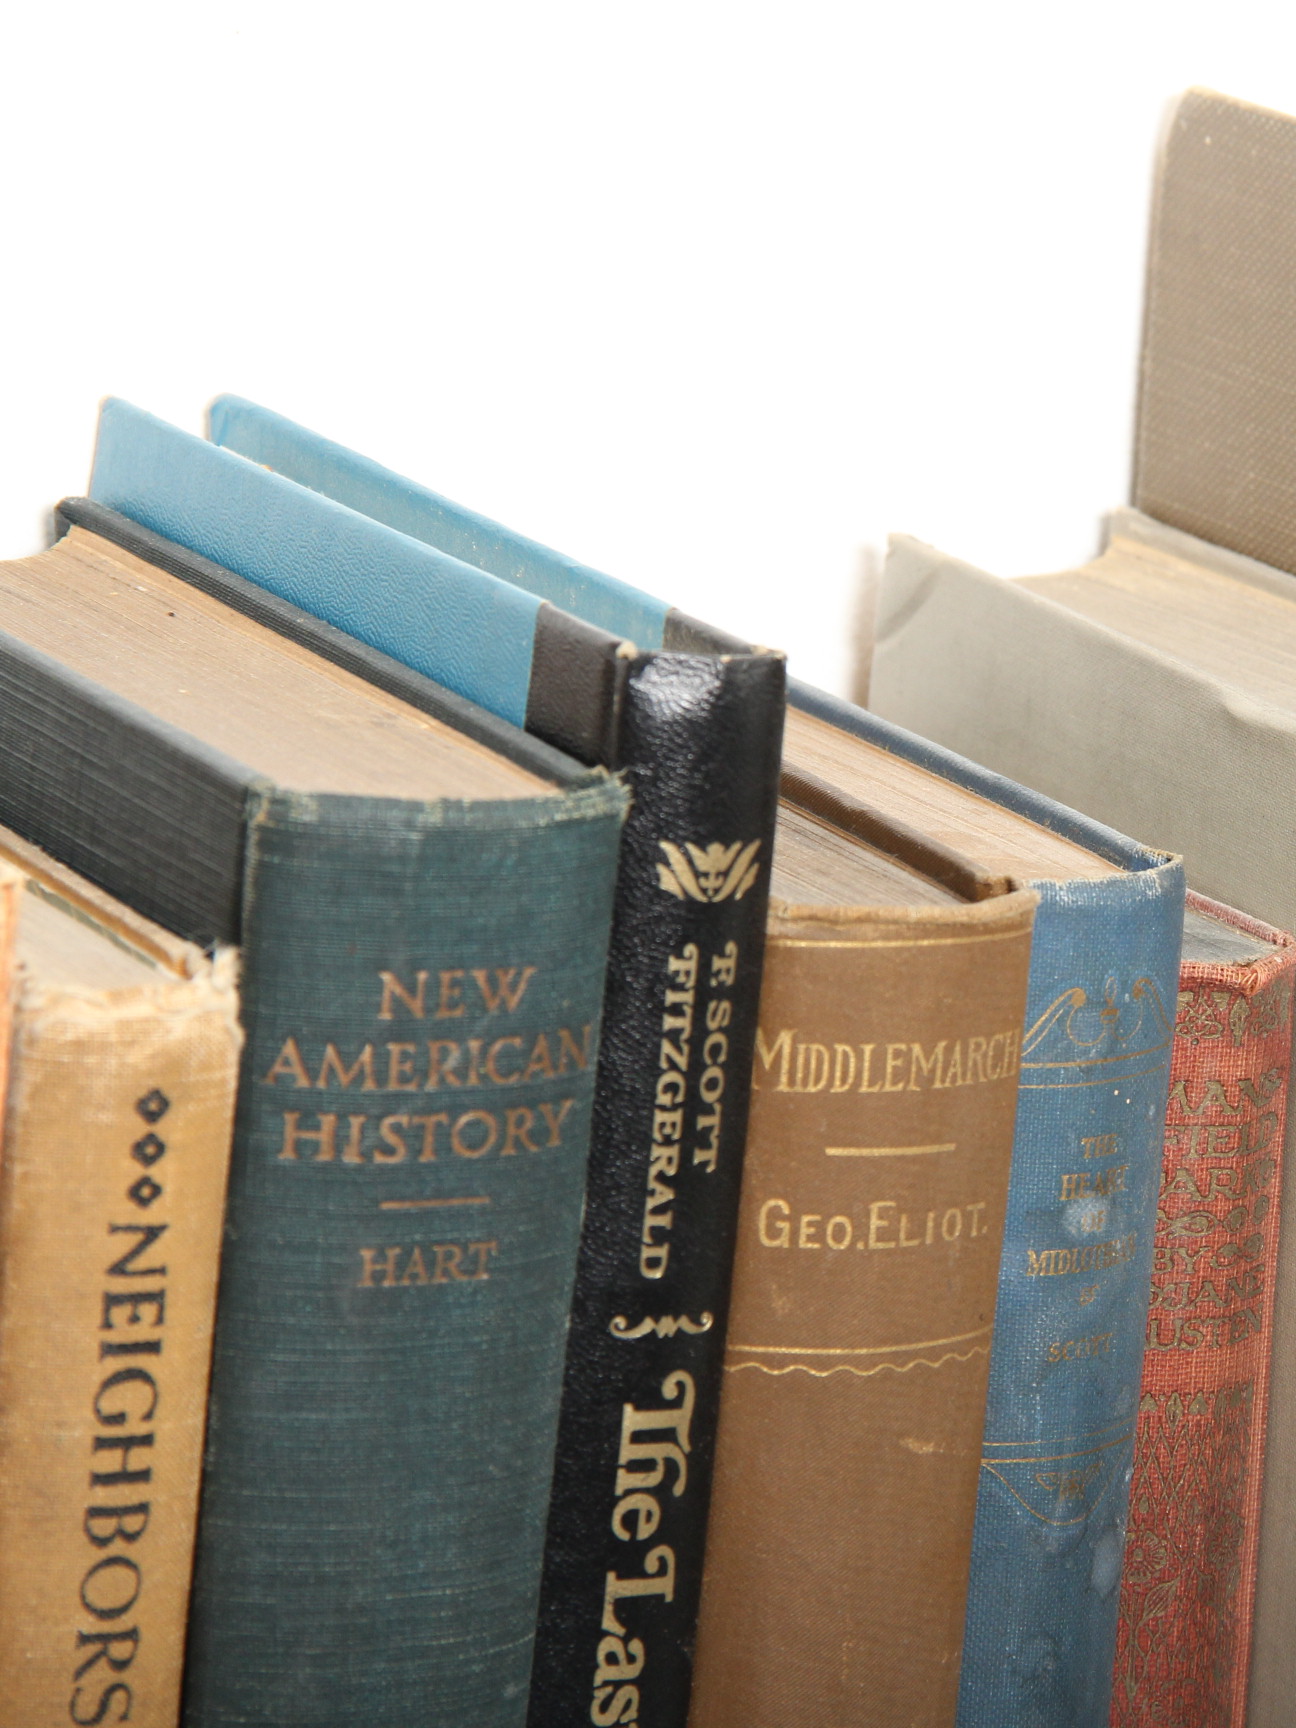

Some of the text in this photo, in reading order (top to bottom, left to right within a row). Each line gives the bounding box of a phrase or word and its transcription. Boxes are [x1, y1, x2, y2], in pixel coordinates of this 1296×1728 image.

[377, 966, 537, 1021] NEW
[260, 1023, 593, 1093] AMERICAN
[693, 940, 738, 1174] F. SCOTT
[752, 1027, 1021, 1094] MIDDLEMARCH
[277, 1098, 576, 1165] HISTORY
[639, 942, 699, 1280] FITZGERALD
[1058, 1164, 1130, 1201] HEART
[357, 1241, 498, 1288] HART
[1047, 1331, 1114, 1363] SCOTT
[1144, 1303, 1264, 1351] USTEN
[68, 1222, 169, 1726] NEIGHBORS
[590, 1369, 696, 1728] The Las
